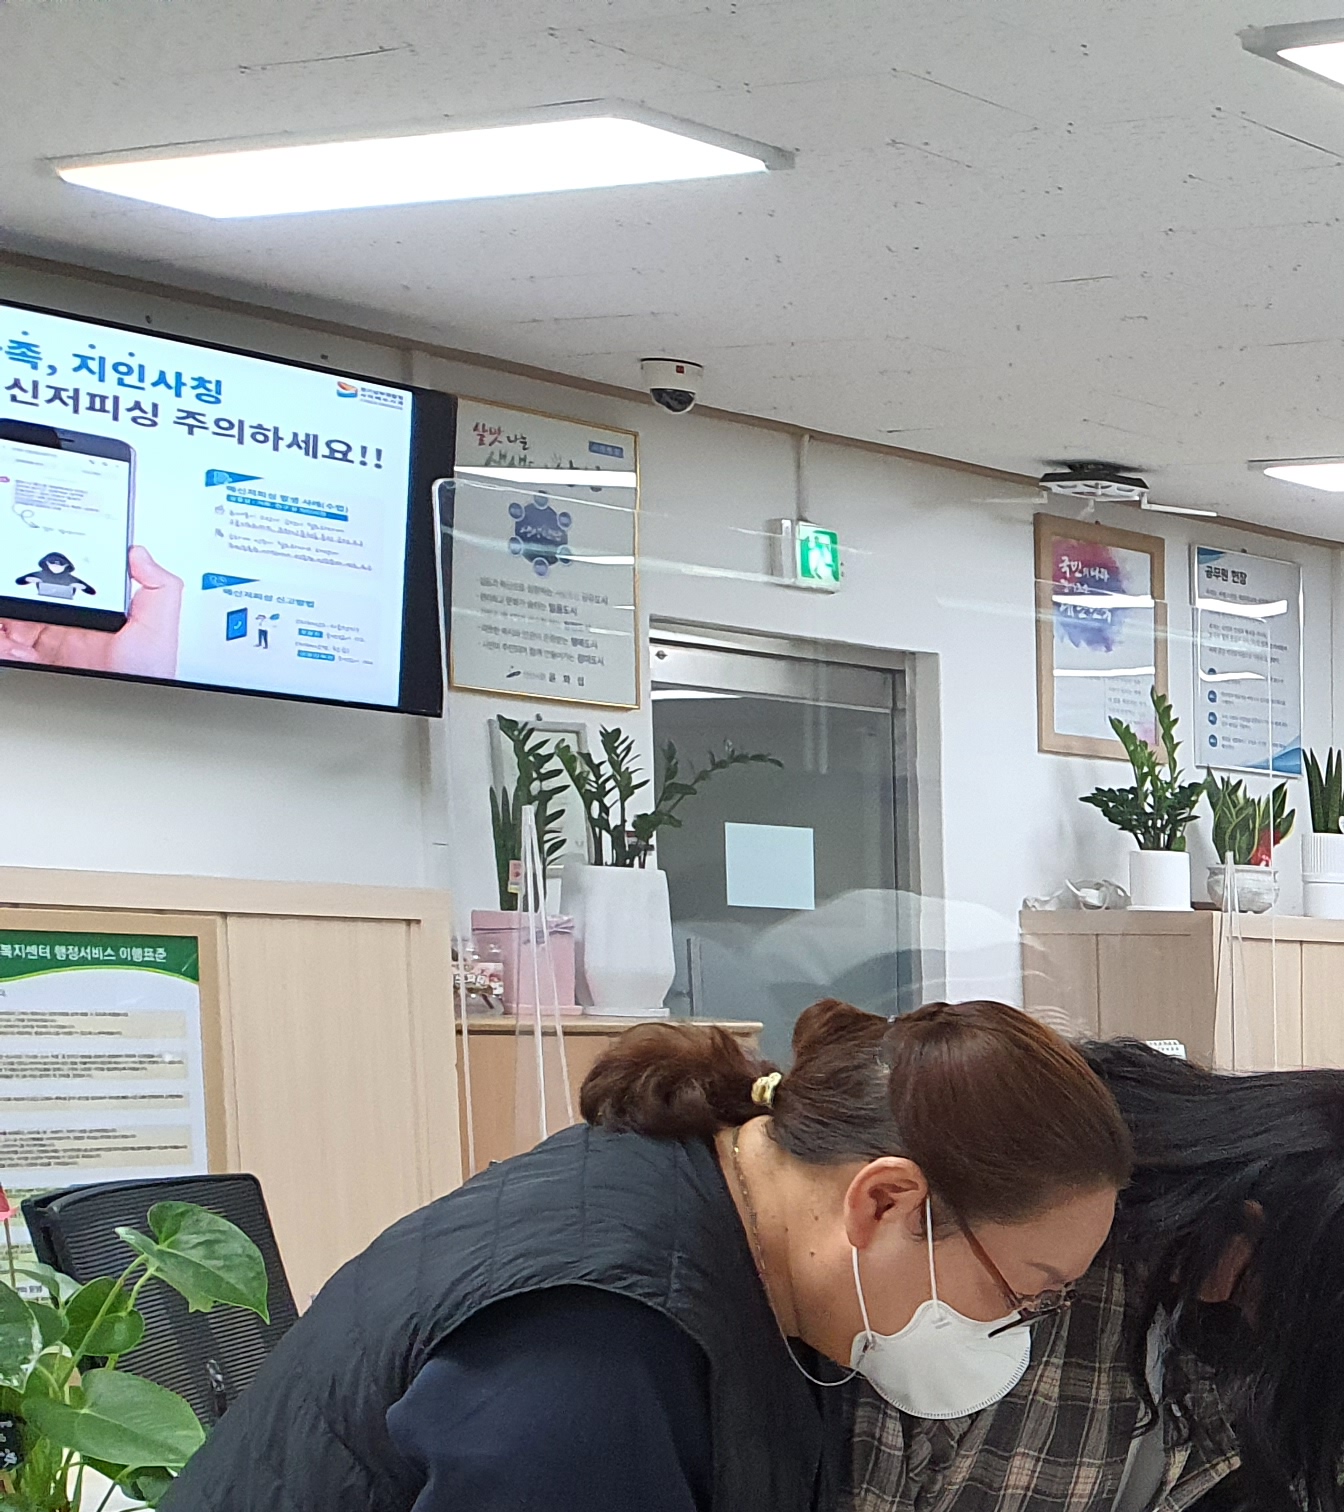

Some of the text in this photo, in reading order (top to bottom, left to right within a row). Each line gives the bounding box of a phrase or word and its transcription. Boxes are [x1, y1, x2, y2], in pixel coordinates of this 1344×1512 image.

[0, 330, 223, 405] 족, 지인사칭
[4, 377, 383, 469] 신저피싱 주의하세요!!
[1205, 565, 1247, 585] 공무원 헌장
[54, 944, 117, 961] 행정서비스
[119, 947, 167, 963] 이행표준
